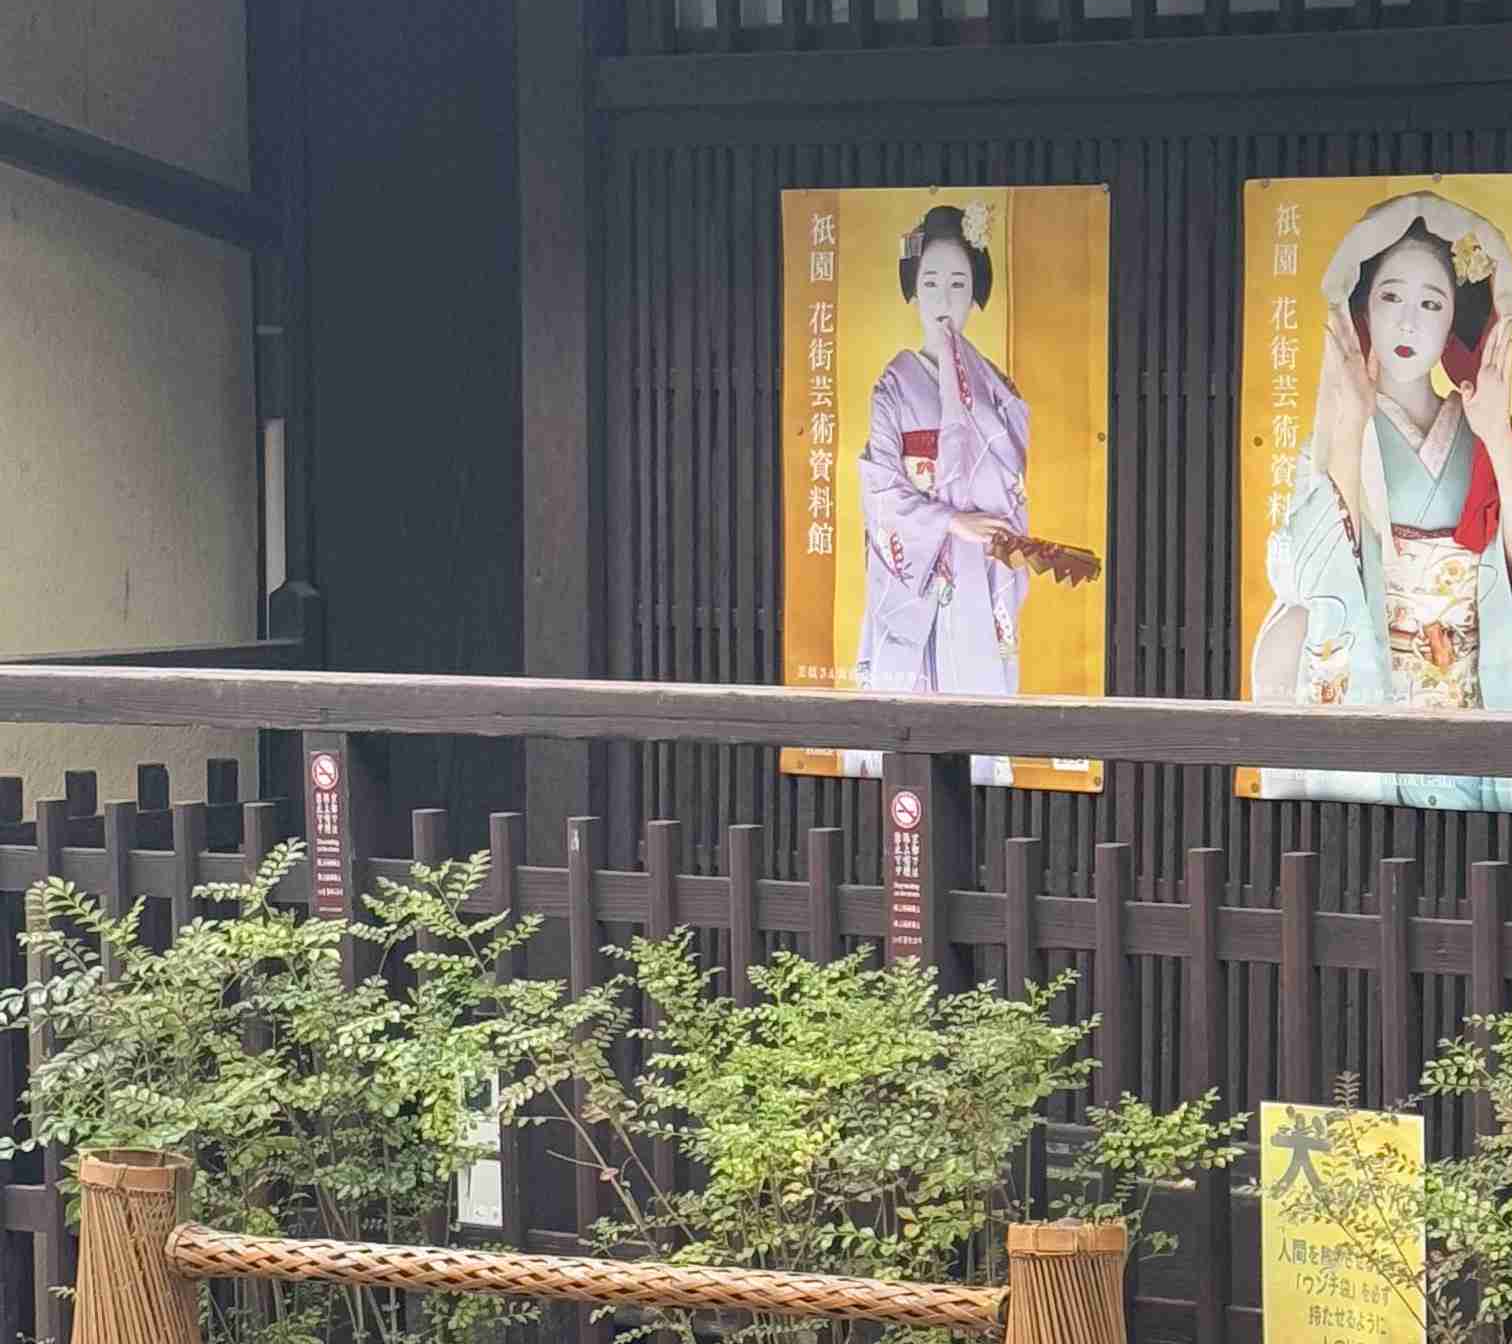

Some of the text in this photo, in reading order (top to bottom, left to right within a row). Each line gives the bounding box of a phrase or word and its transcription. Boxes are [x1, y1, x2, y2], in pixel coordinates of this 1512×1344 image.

[807, 302, 836, 555] 花街芸術資料館
